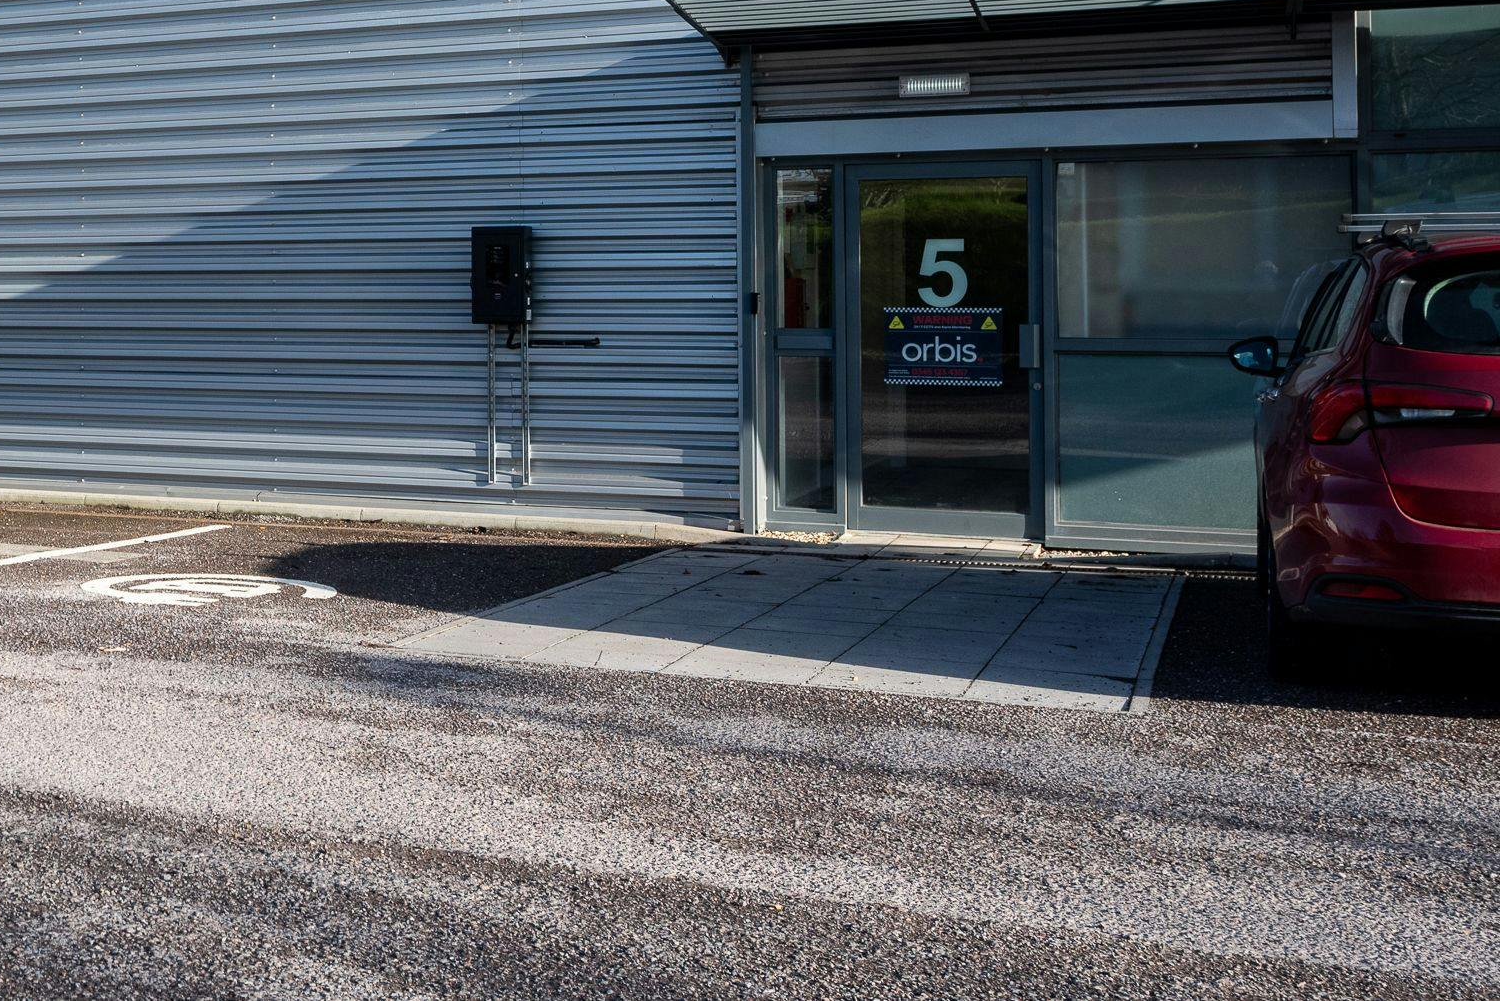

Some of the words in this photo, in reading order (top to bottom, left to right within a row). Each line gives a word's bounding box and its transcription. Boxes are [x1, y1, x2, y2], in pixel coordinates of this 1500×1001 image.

[918, 238, 968, 307] 5
[913, 316, 972, 325] WARNING
[902, 336, 977, 363] orbis
